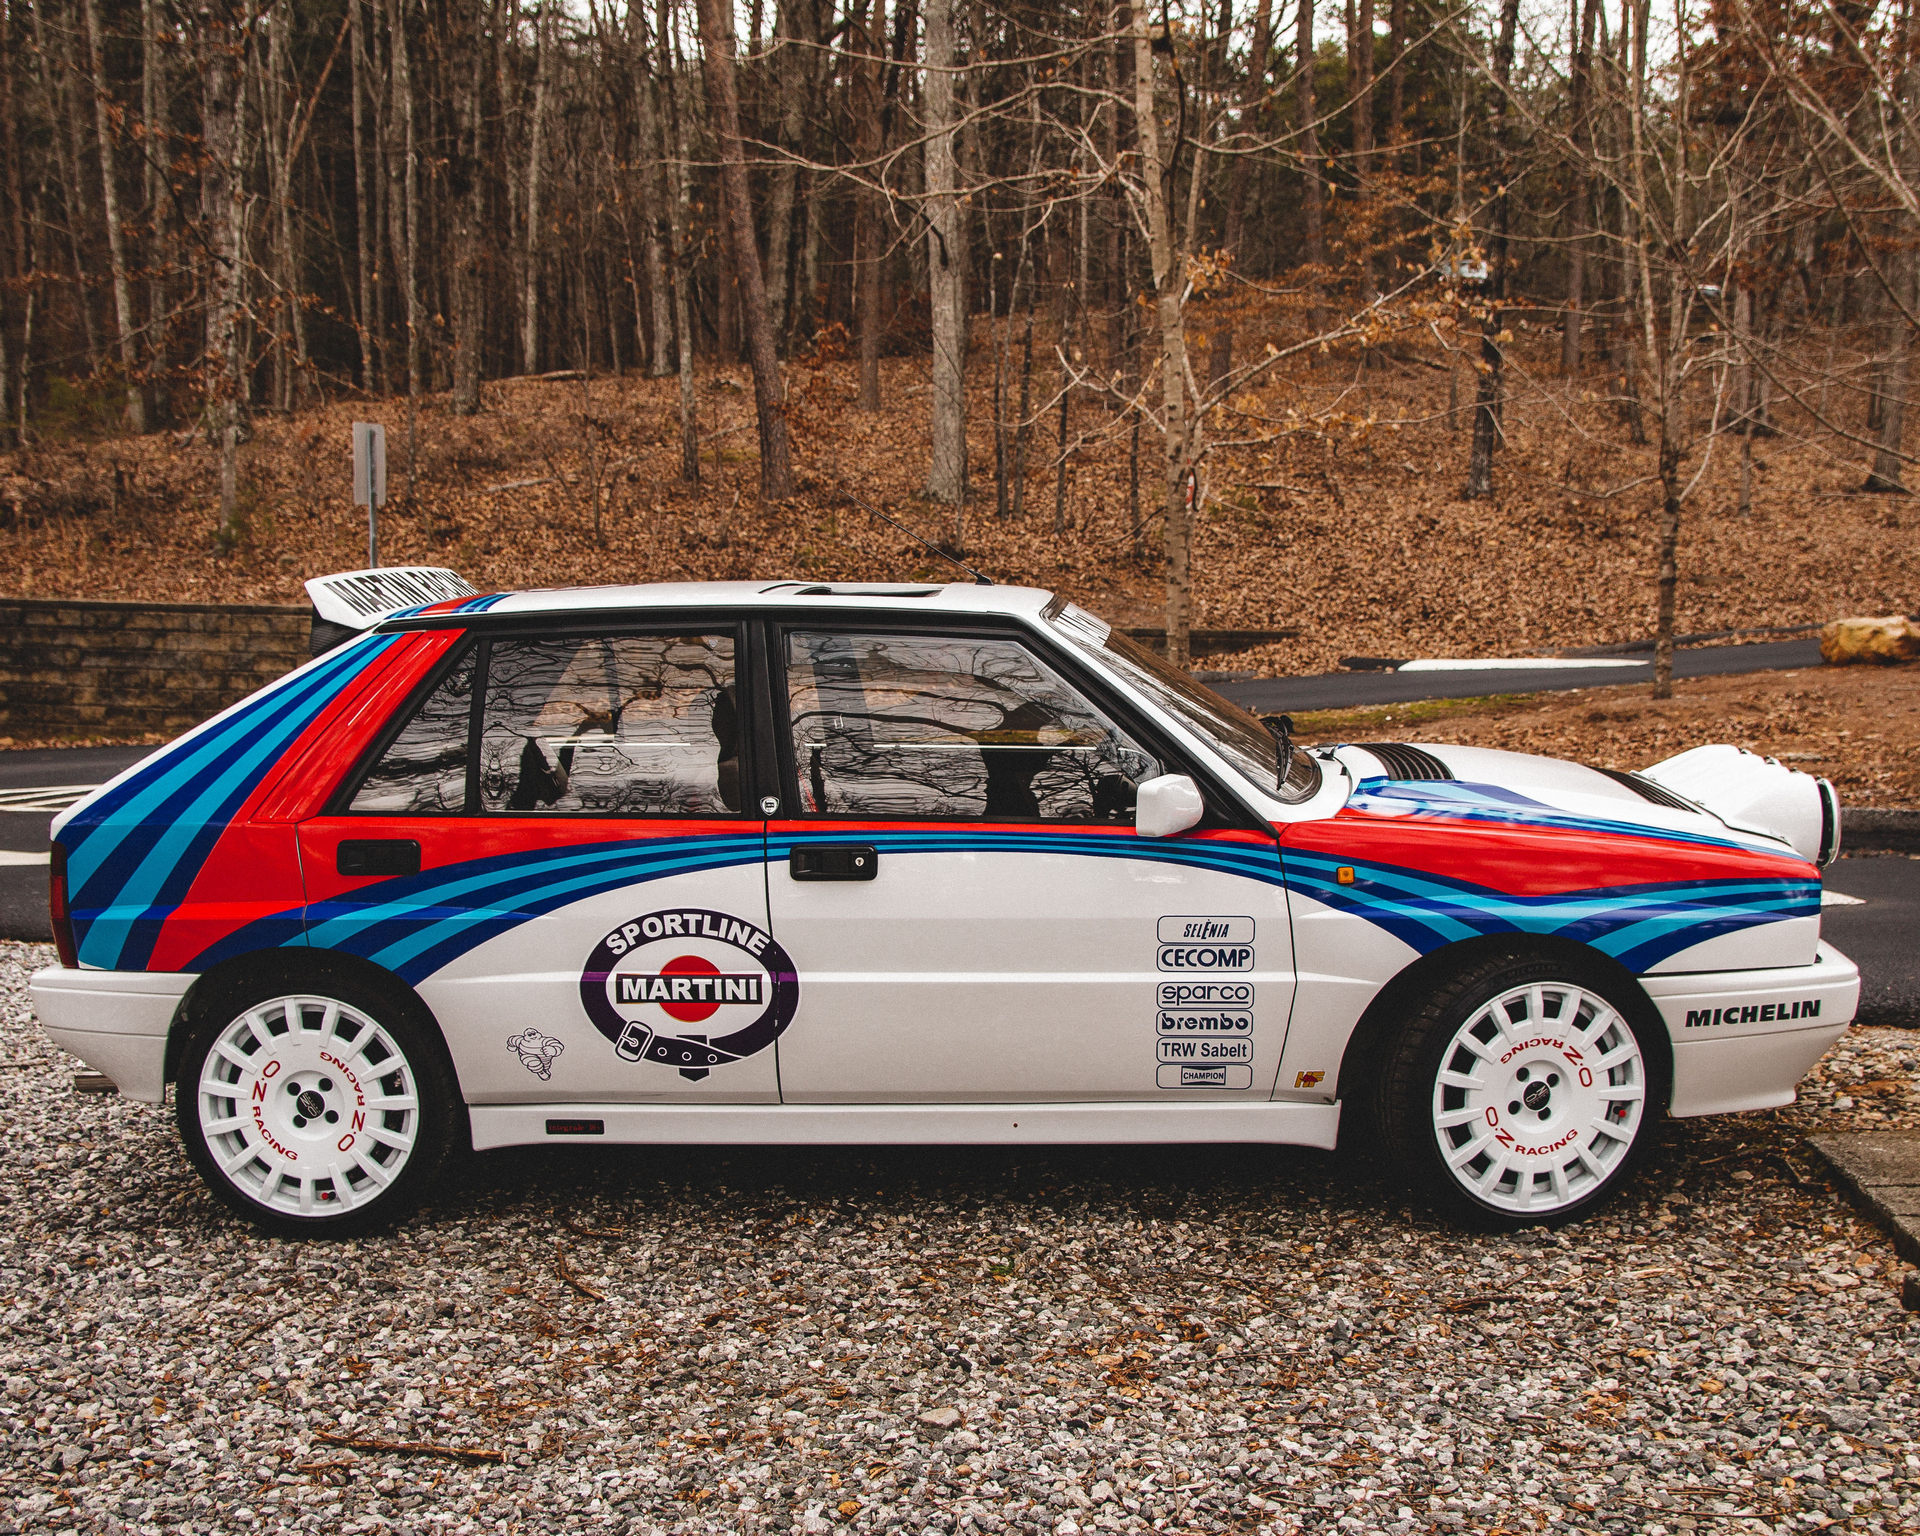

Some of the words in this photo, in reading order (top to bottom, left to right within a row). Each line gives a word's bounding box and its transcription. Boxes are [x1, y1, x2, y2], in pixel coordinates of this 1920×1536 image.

[323, 571, 434, 617] MARTINI
[405, 570, 481, 601] RACING
[605, 913, 771, 956] SPORTLINE
[1161, 948, 1251, 968] CECOMP
[622, 978, 758, 1001] MARTINI
[1162, 985, 1250, 1006] sparco
[1161, 1012, 1249, 1030] brembo
[1685, 999, 1821, 1028] MICHELIN
[1161, 1042, 1197, 1057] TRW
[1200, 1042, 1248, 1058] Sabelt
[1500, 1037, 1565, 1065] RACING
[319, 1051, 366, 1107] RACING
[1183, 1071, 1225, 1080] CHAMPION
[252, 1105, 298, 1161] RACING
[1514, 1128, 1578, 1156] RACING
